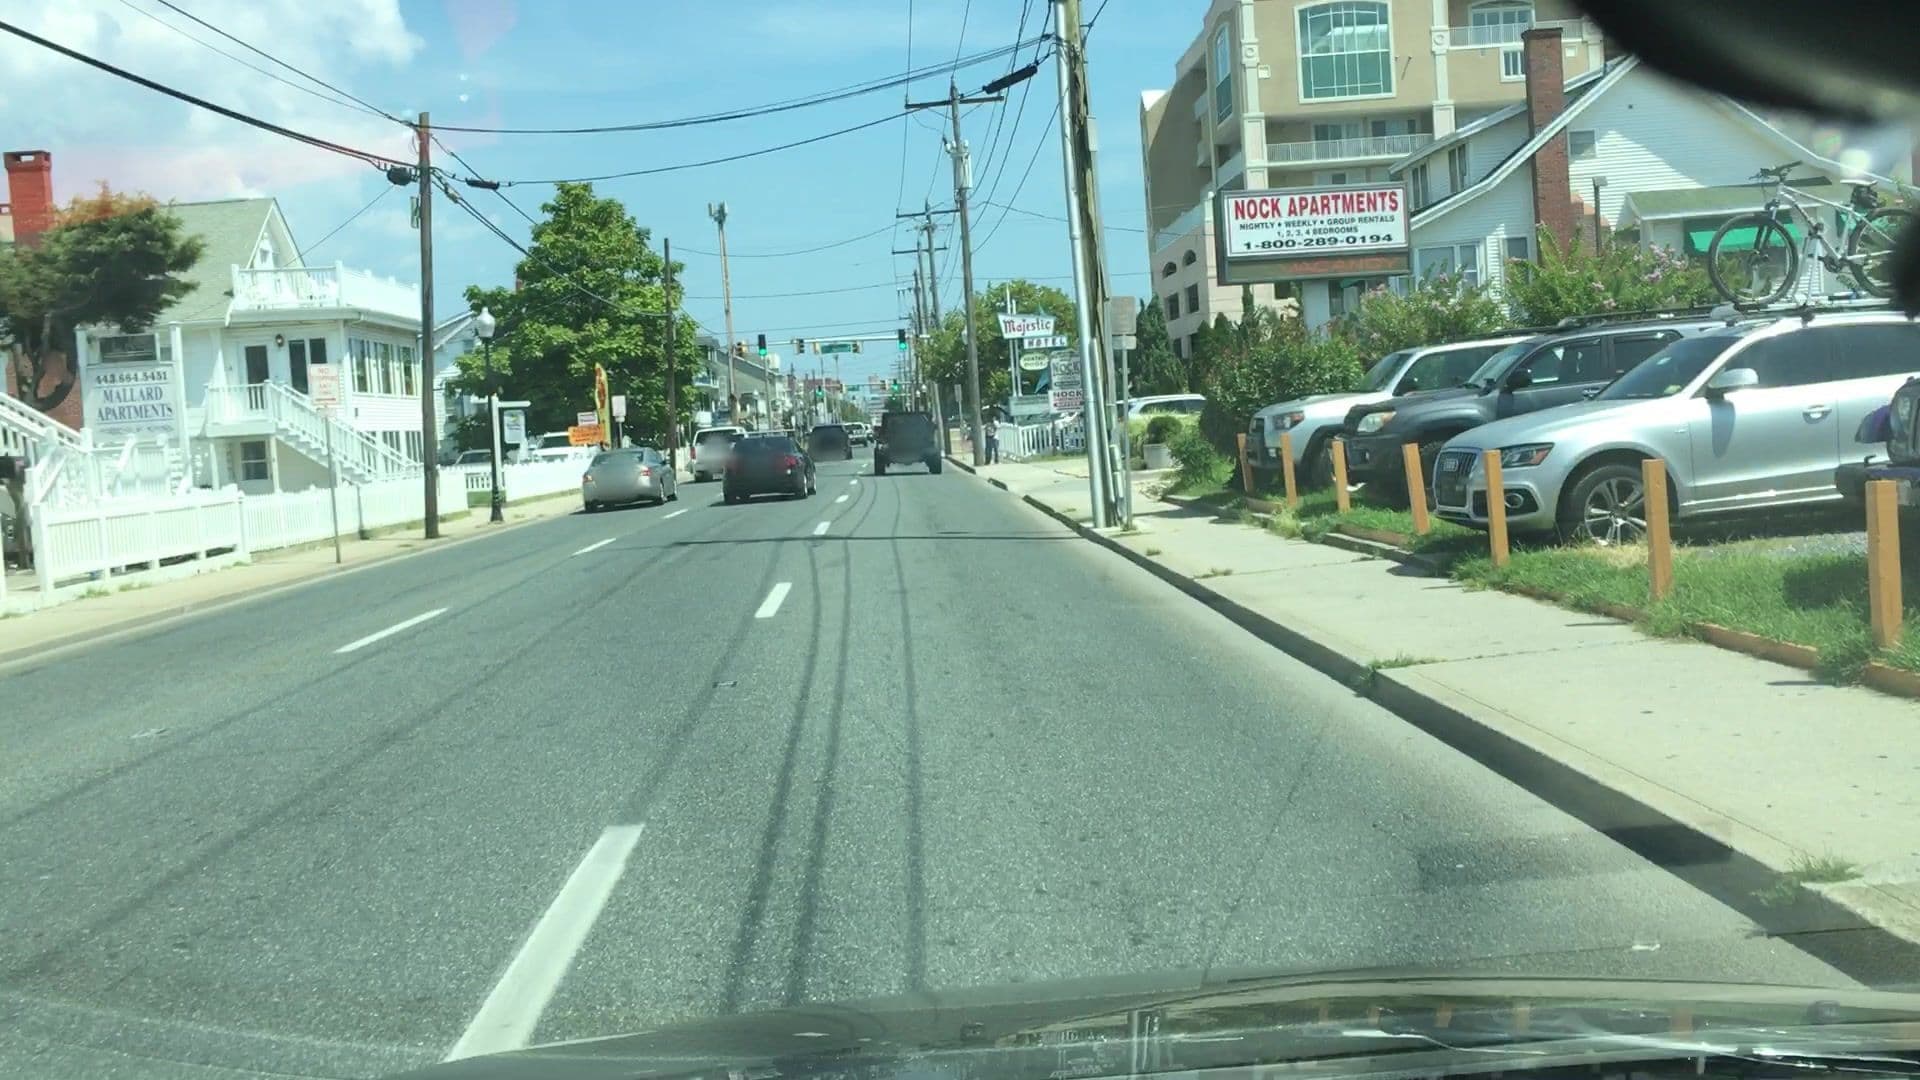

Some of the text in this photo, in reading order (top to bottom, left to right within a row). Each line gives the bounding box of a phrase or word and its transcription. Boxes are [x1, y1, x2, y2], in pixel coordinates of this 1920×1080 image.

[1235, 190, 1398, 220] NOCK APARTMENTS
[1240, 215, 1395, 231] NIGHTLY WEEKLY GROUP RENTALS
[1312, 226, 1359, 236] BEDROOMS
[1243, 233, 1393, 250] 1-800-289-0194
[1003, 317, 1052, 336] Majestic
[104, 386, 163, 403] MALLARD
[97, 403, 173, 421] APARTMENTS
